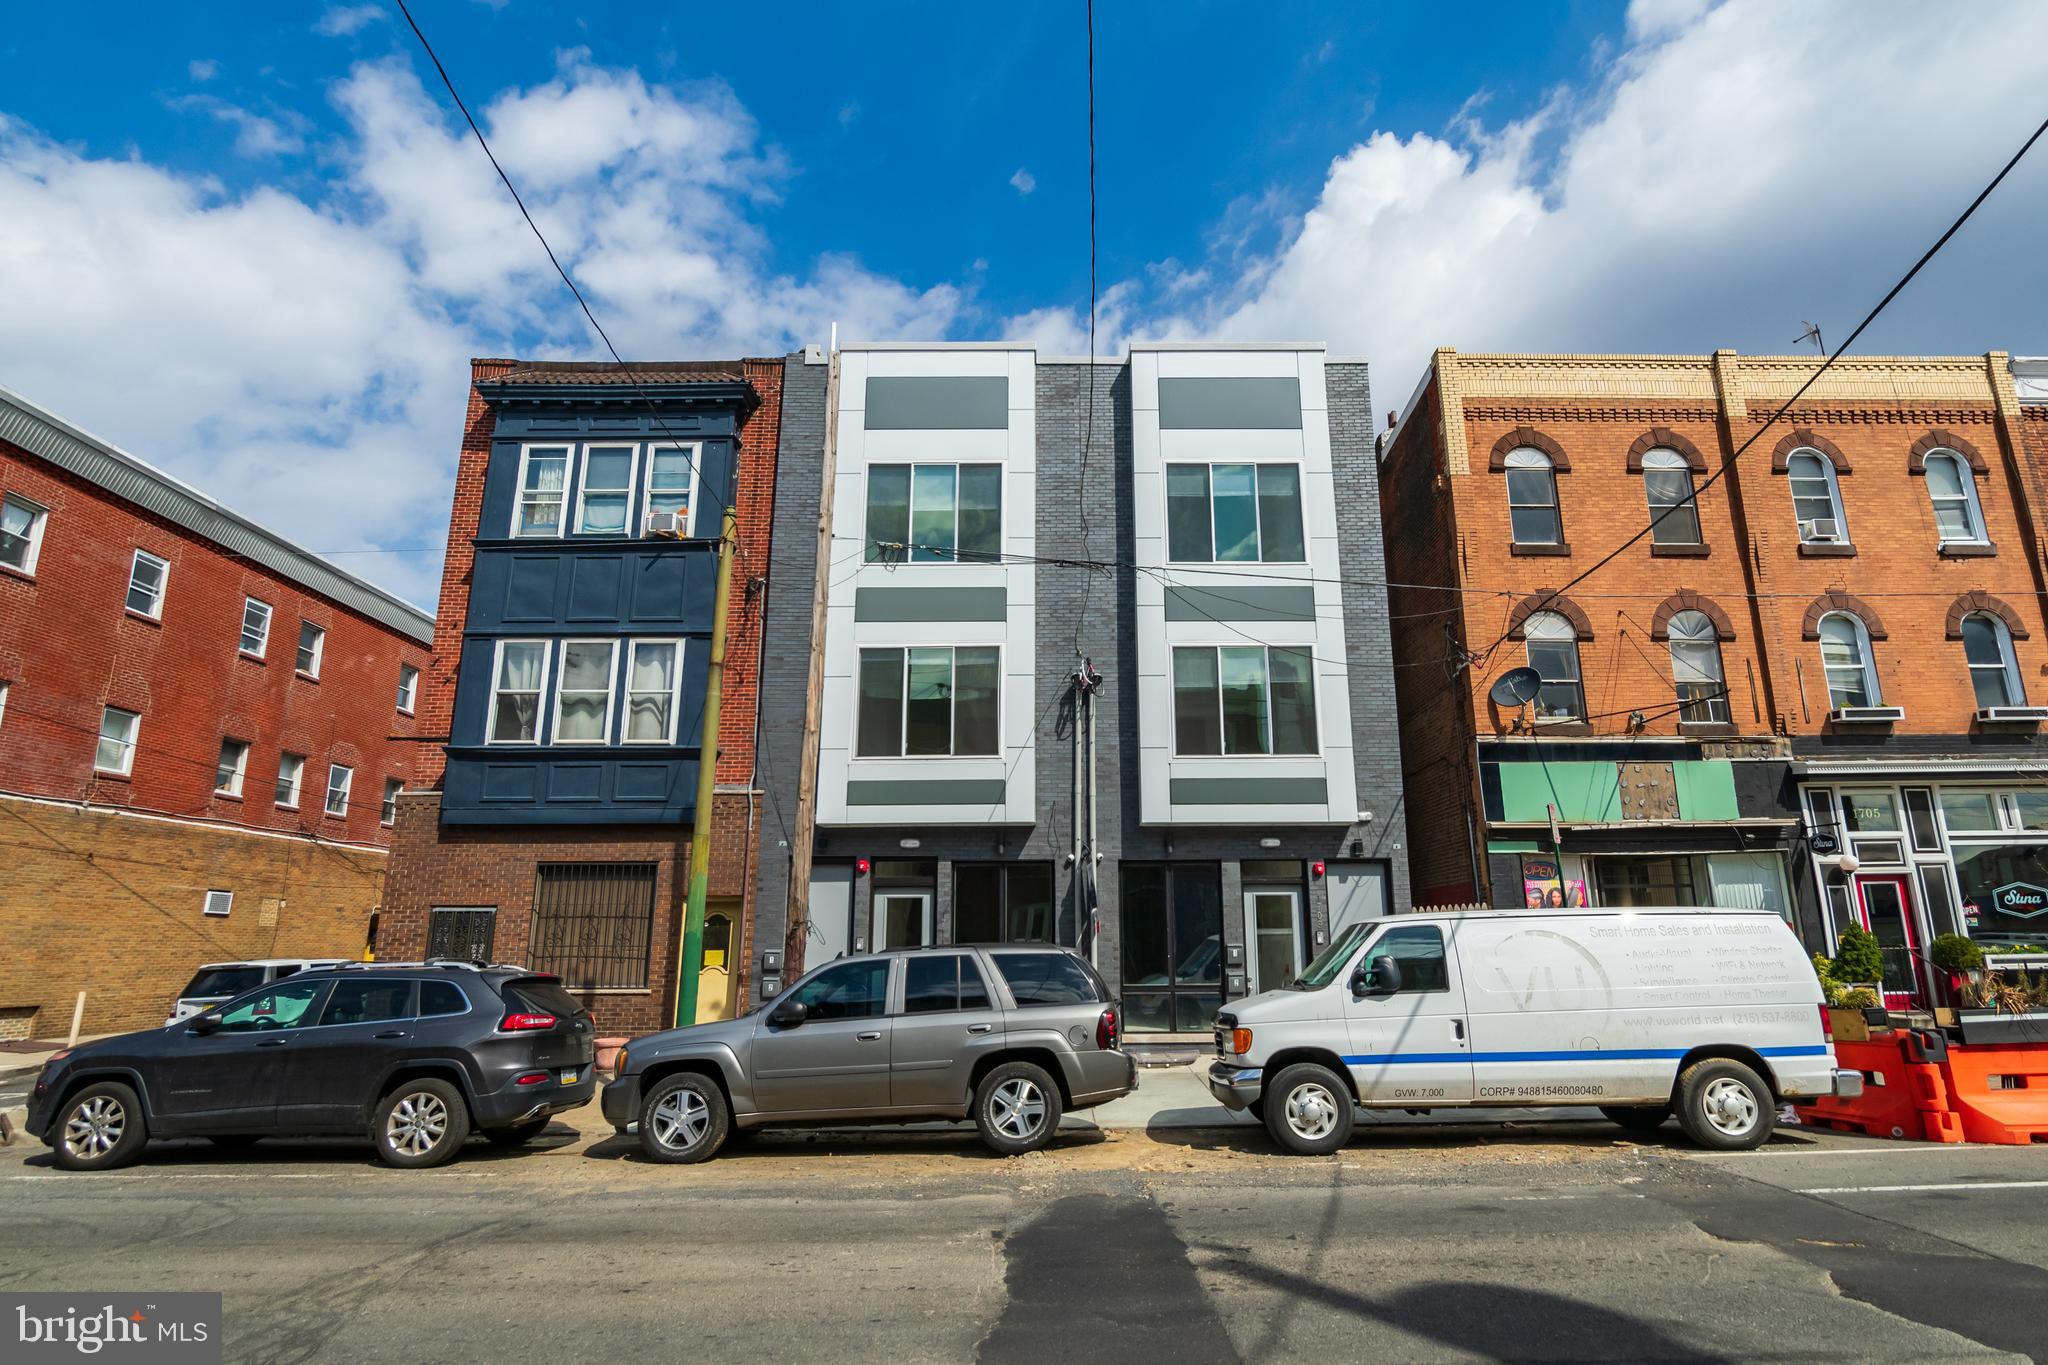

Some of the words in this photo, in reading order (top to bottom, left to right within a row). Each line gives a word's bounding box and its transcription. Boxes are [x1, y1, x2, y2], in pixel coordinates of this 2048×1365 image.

[1853, 808, 1880, 819] 1705
[1524, 865, 1555, 877] OPEN
[2004, 889, 2042, 905] Stina
[1589, 925, 1621, 938] Smart
[1624, 925, 1656, 937] Home
[1658, 924, 1689, 936] Sales
[1692, 924, 1712, 936] and
[1714, 923, 1772, 936] Installation
[1732, 1013, 1759, 1026] (215)
[1395, 1089, 1419, 1097] GVW:
[1480, 1087, 1515, 1097] CORP#
[1517, 1085, 1604, 1096] 948815460080480
